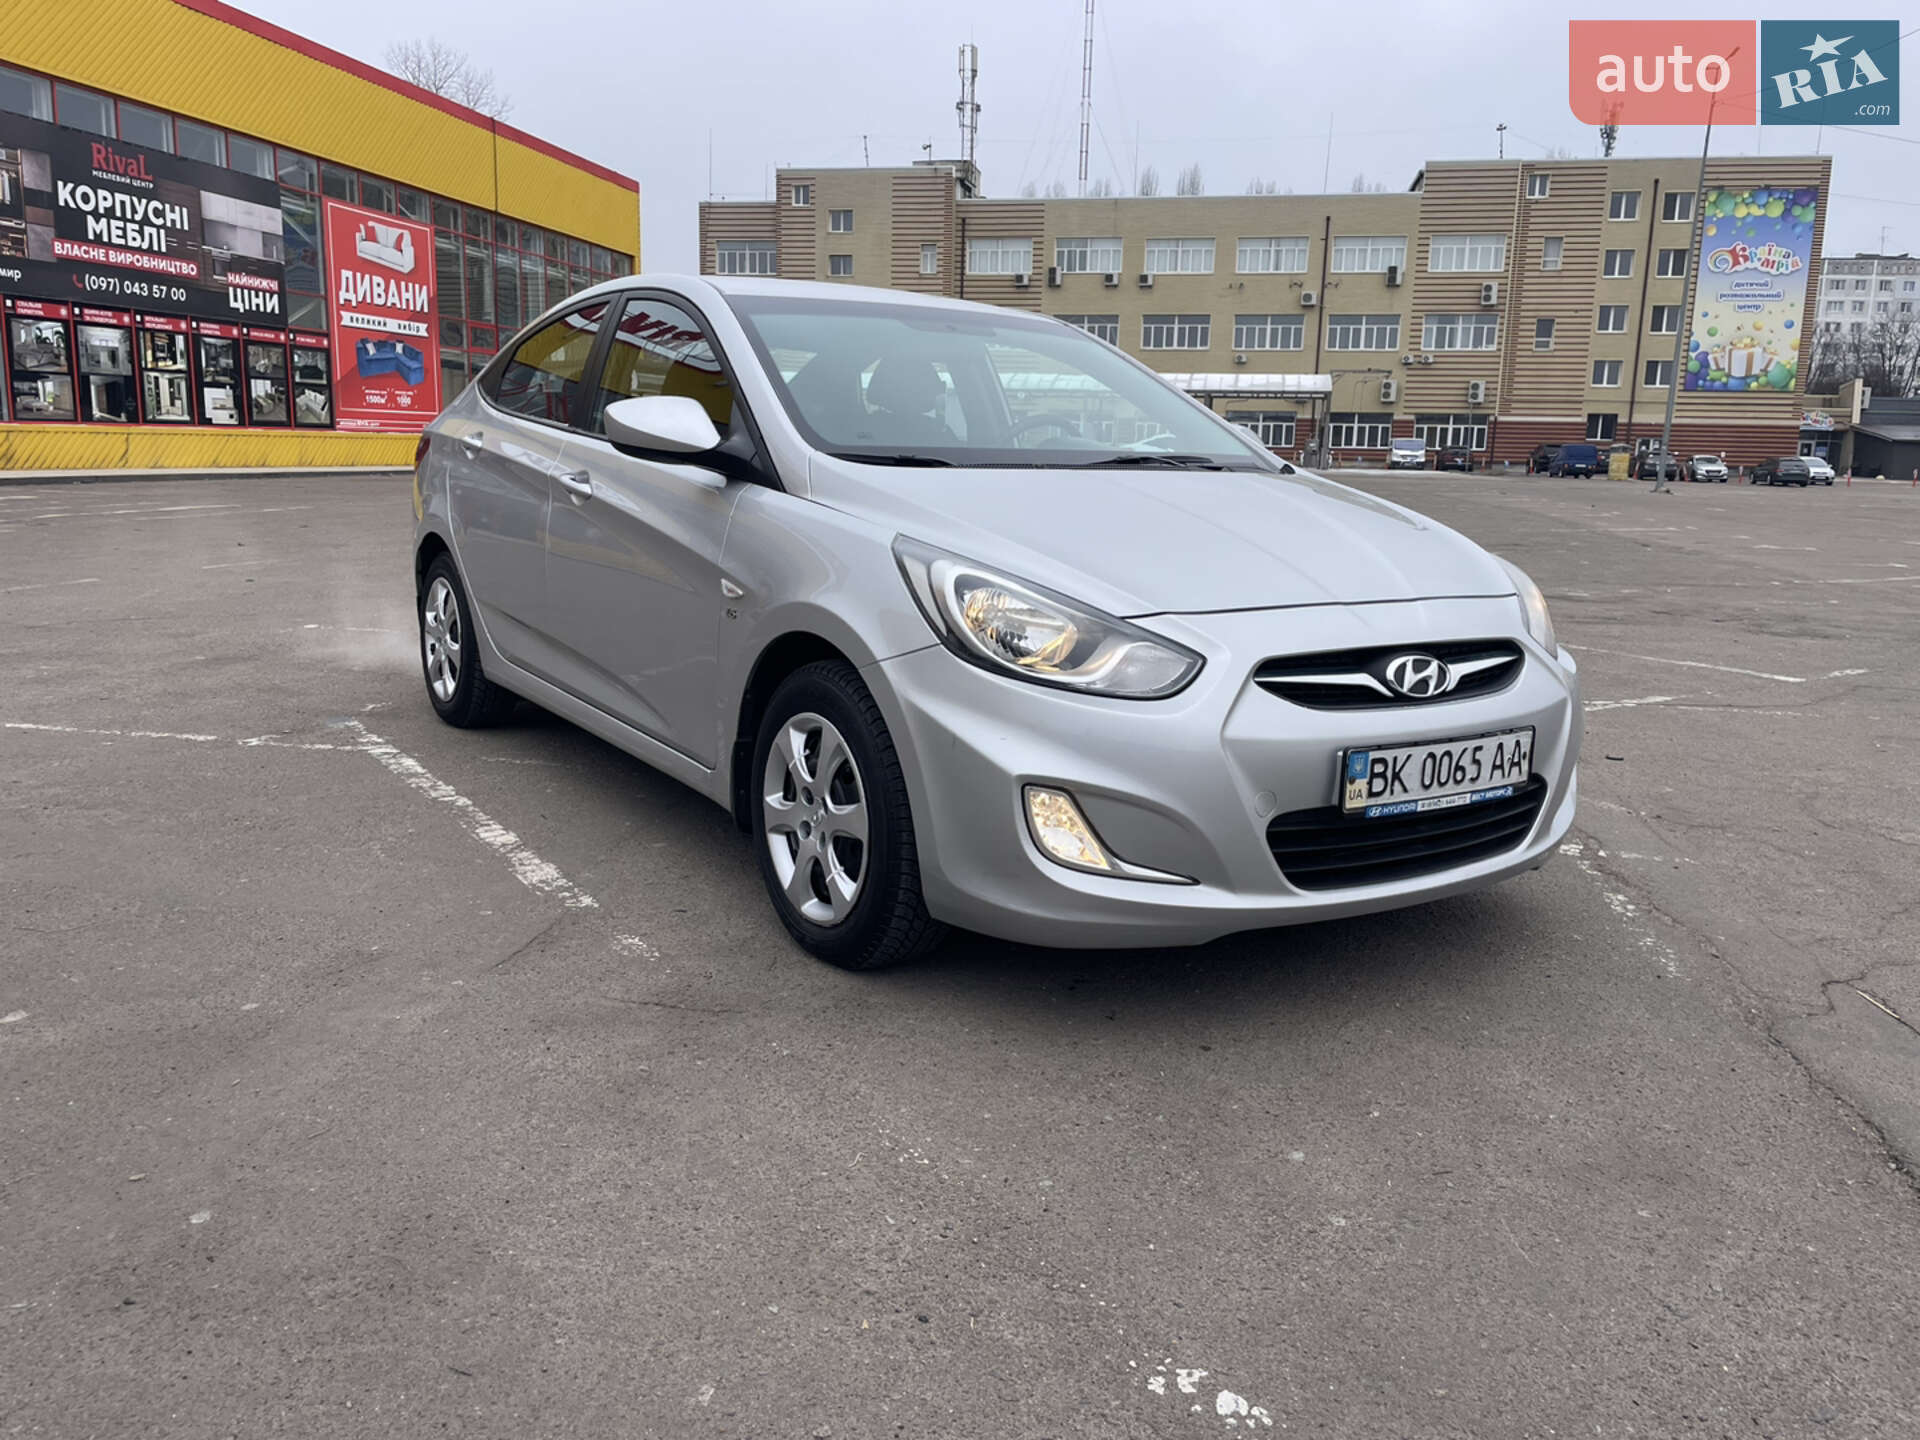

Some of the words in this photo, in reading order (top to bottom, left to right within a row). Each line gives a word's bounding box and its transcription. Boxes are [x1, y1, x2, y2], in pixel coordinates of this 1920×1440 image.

[92, 169, 131, 185] МЕБЛЕВИЙ
[131, 177, 154, 190] ЦЕНТР
[56, 180, 189, 231] КОРПУСНІ
[86, 214, 167, 253] МЕБЛІ
[53, 241, 107, 261] ВЛАСНЕ
[108, 250, 198, 276] ВИРОБНИЦТВО
[84, 273, 120, 294] (097)
[123, 280, 149, 297] 043
[152, 284, 167, 299] 57
[170, 288, 187, 301] 00
[227, 272, 279, 292] НАЙНИЖЧІ
[339, 269, 429, 313] ДИВАНИ
[228, 286, 279, 315] ЦІНИ
[1367, 754, 1412, 799] BK
[1421, 744, 1484, 791] 0065
[1489, 739, 1523, 781] AA
[1348, 789, 1364, 801] UA
